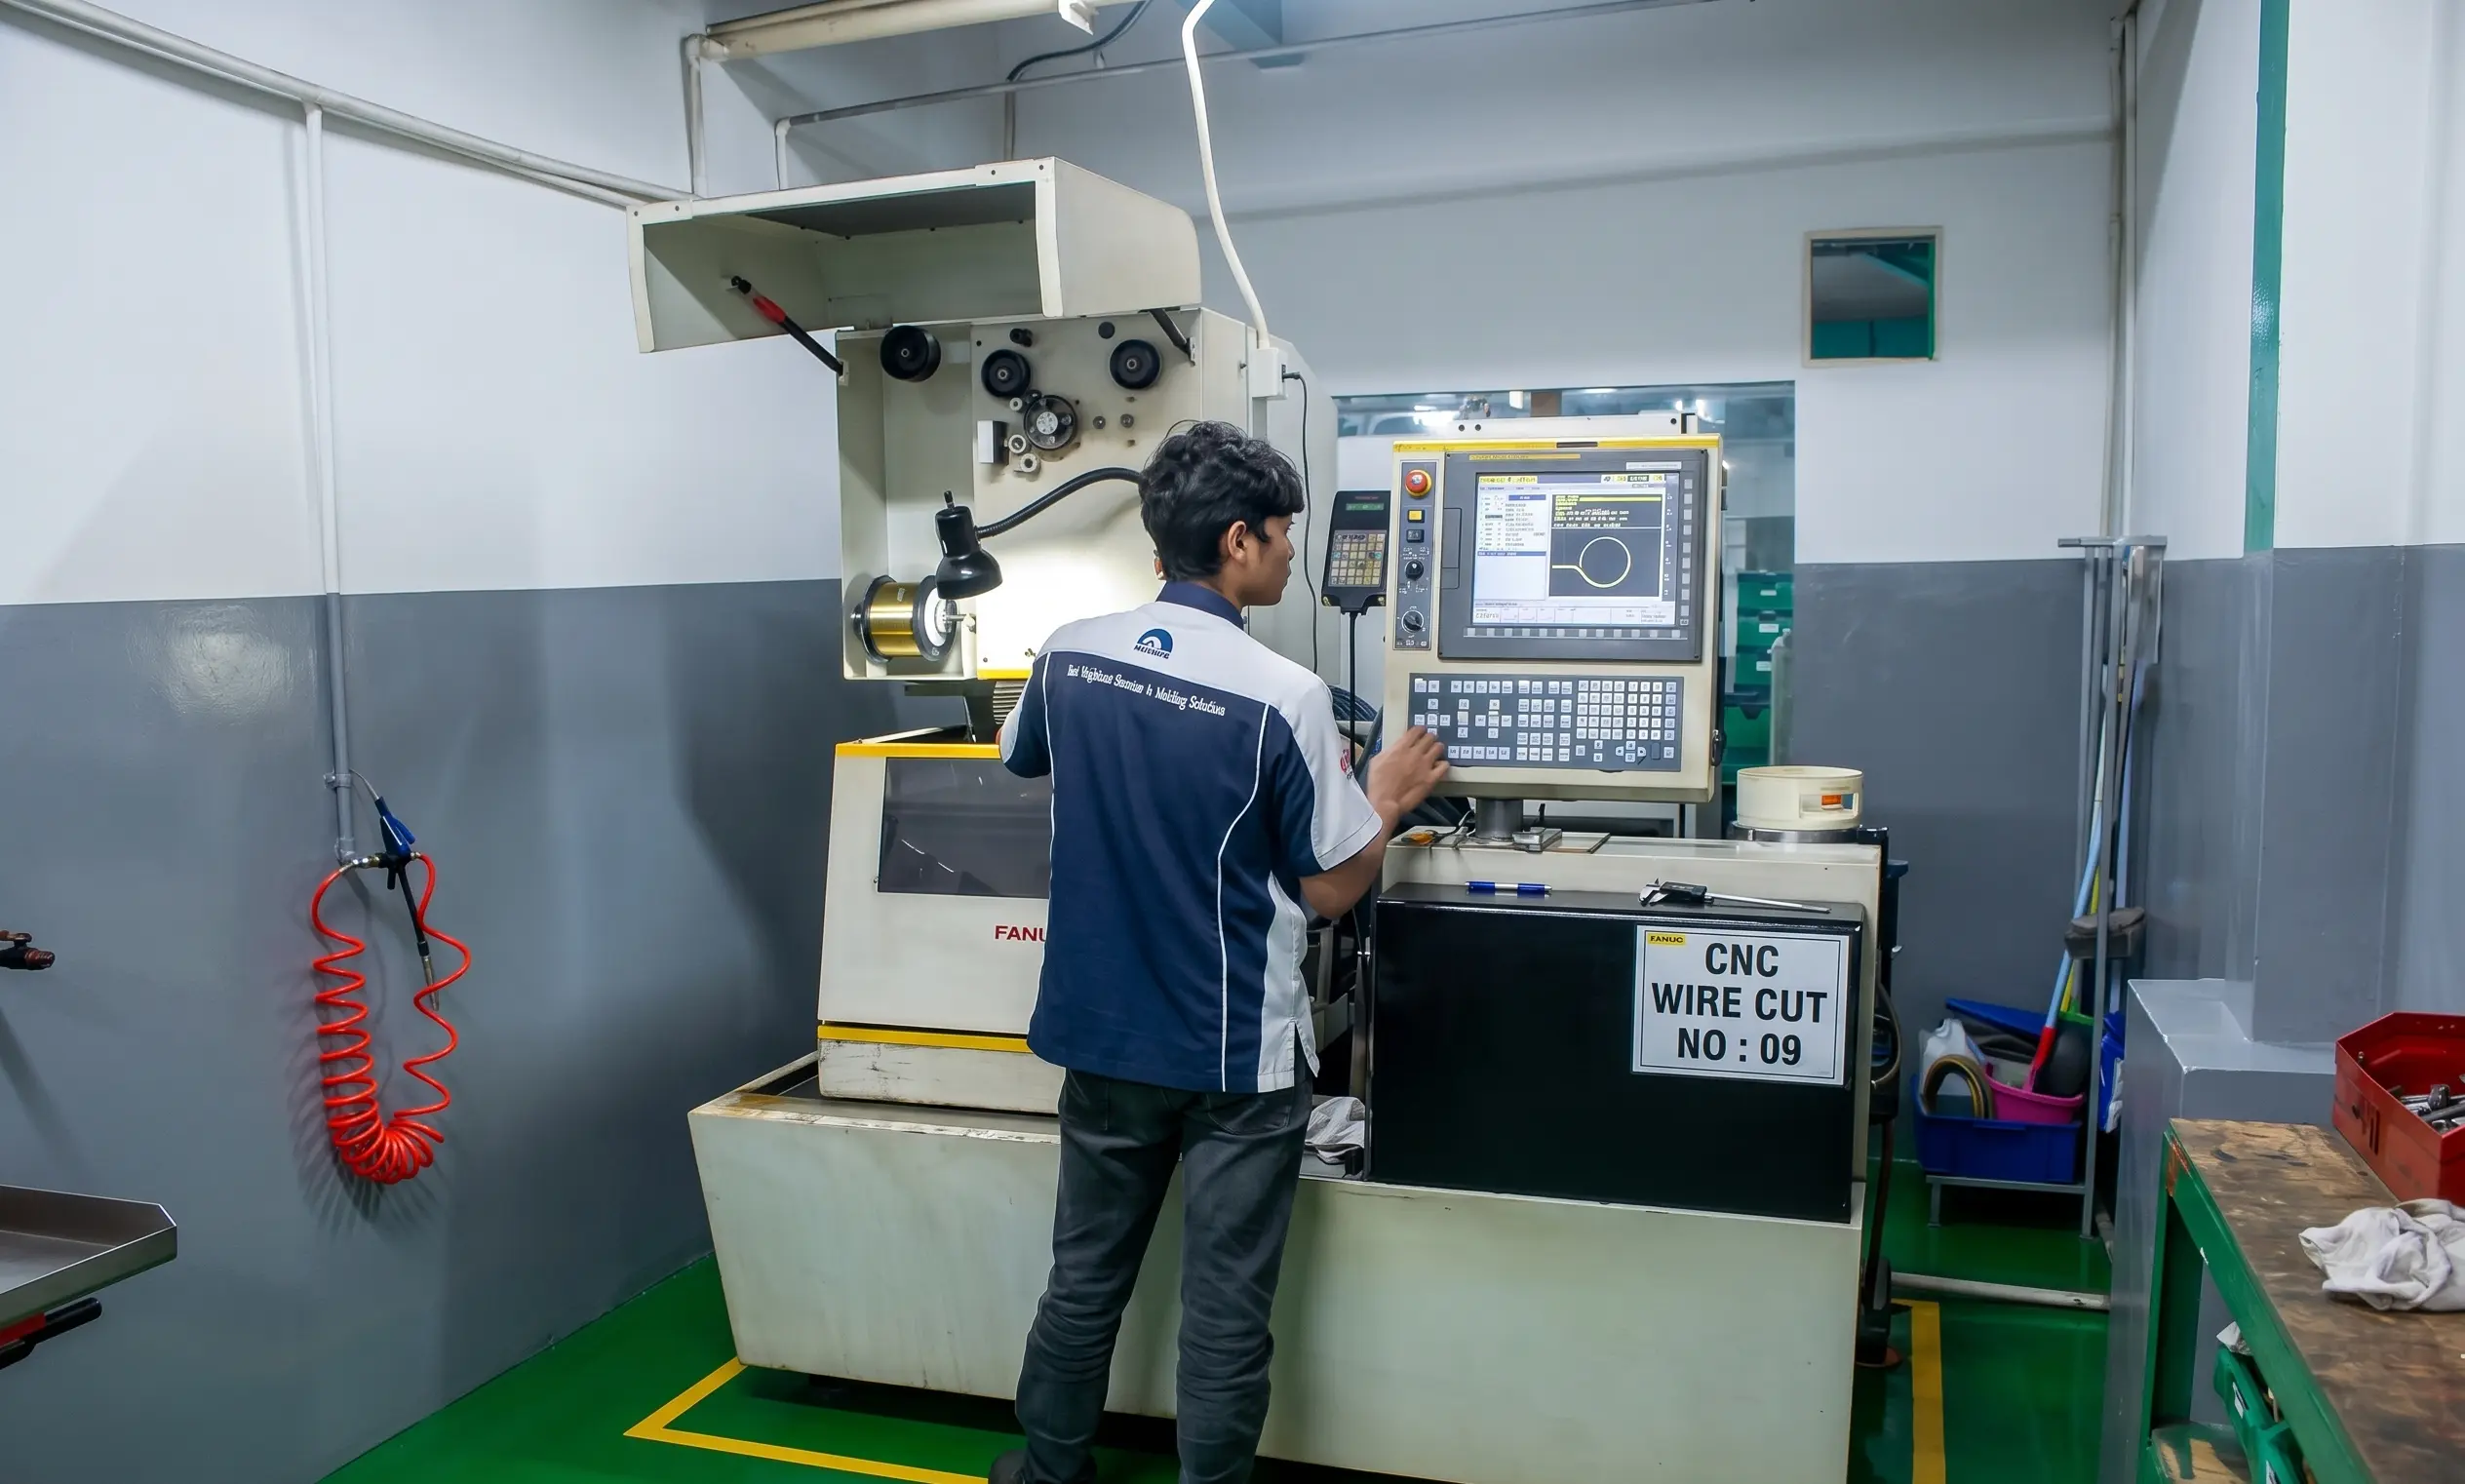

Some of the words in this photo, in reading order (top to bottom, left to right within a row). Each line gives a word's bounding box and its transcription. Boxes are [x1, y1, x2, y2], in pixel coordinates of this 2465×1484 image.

[995, 925, 1046, 942] FANU
[1650, 935, 1684, 944] FANUC
[1705, 942, 1780, 978] CNC
[1651, 982, 1742, 1018] WIRE
[1755, 988, 1828, 1023] CUT
[1677, 1027, 1727, 1062] NO
[1760, 1033, 1802, 1066] 09
